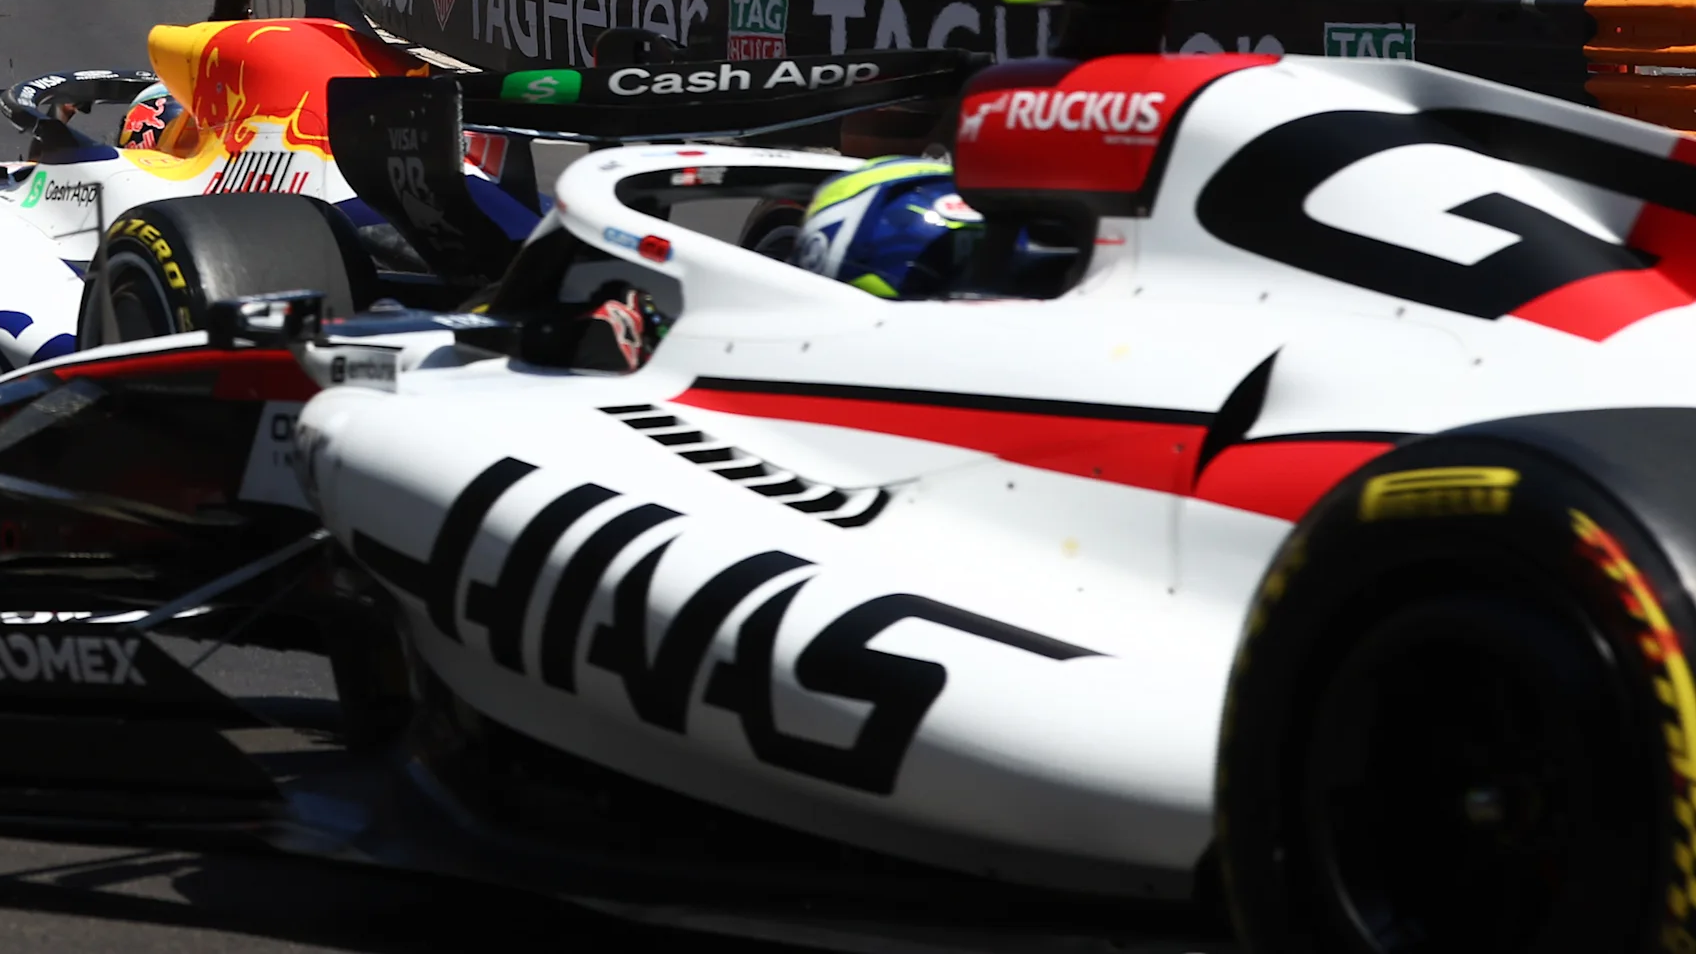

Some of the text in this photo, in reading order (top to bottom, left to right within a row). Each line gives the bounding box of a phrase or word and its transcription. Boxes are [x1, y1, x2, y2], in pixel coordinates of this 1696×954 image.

[1331, 31, 1410, 61] TAG
[31, 75, 67, 90] VISA
[607, 64, 751, 96] Cash
[762, 58, 879, 89] App
[1006, 90, 1166, 133] RUCKUS
[388, 127, 419, 151] VISA
[45, 180, 71, 201] Cash
[70, 181, 97, 207] App
[124, 217, 188, 290] ZERO
[348, 454, 1116, 798] HAAS
